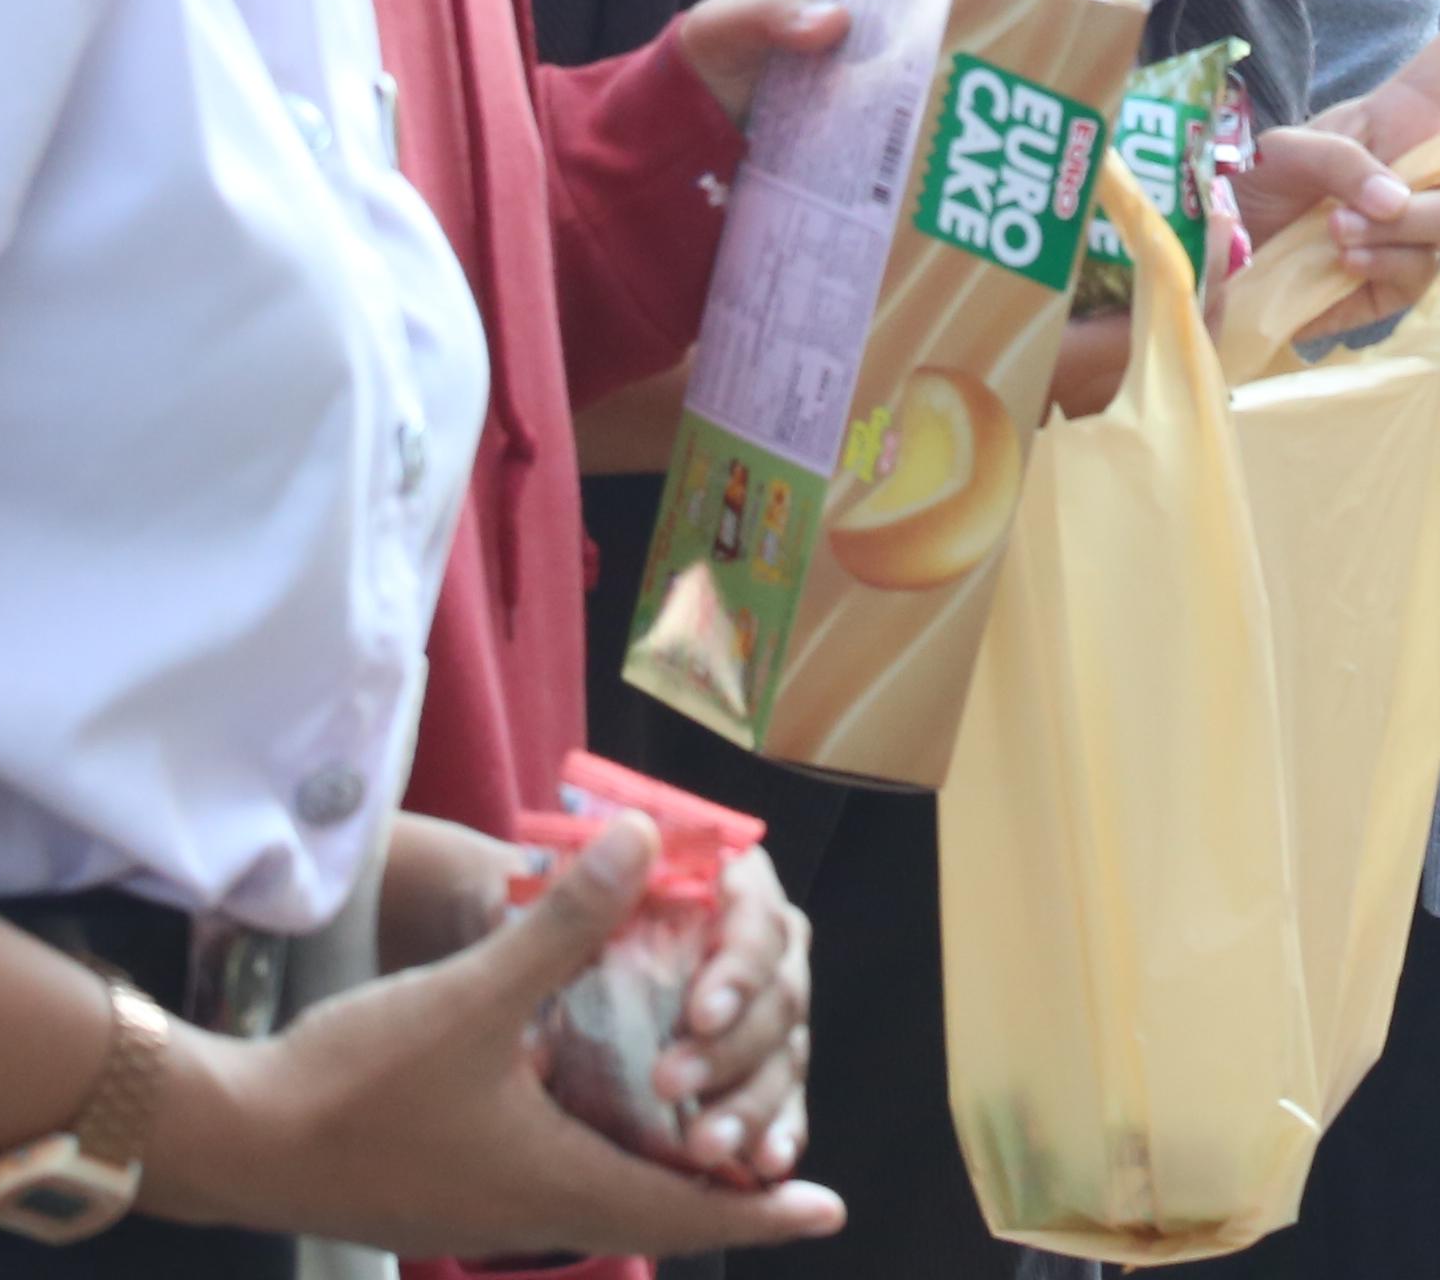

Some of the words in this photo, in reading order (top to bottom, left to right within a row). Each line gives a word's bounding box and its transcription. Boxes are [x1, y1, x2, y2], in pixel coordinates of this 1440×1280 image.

[935, 67, 1011, 249] CAKE
[989, 83, 1064, 269] EURO
[1052, 116, 1099, 221] EURO
